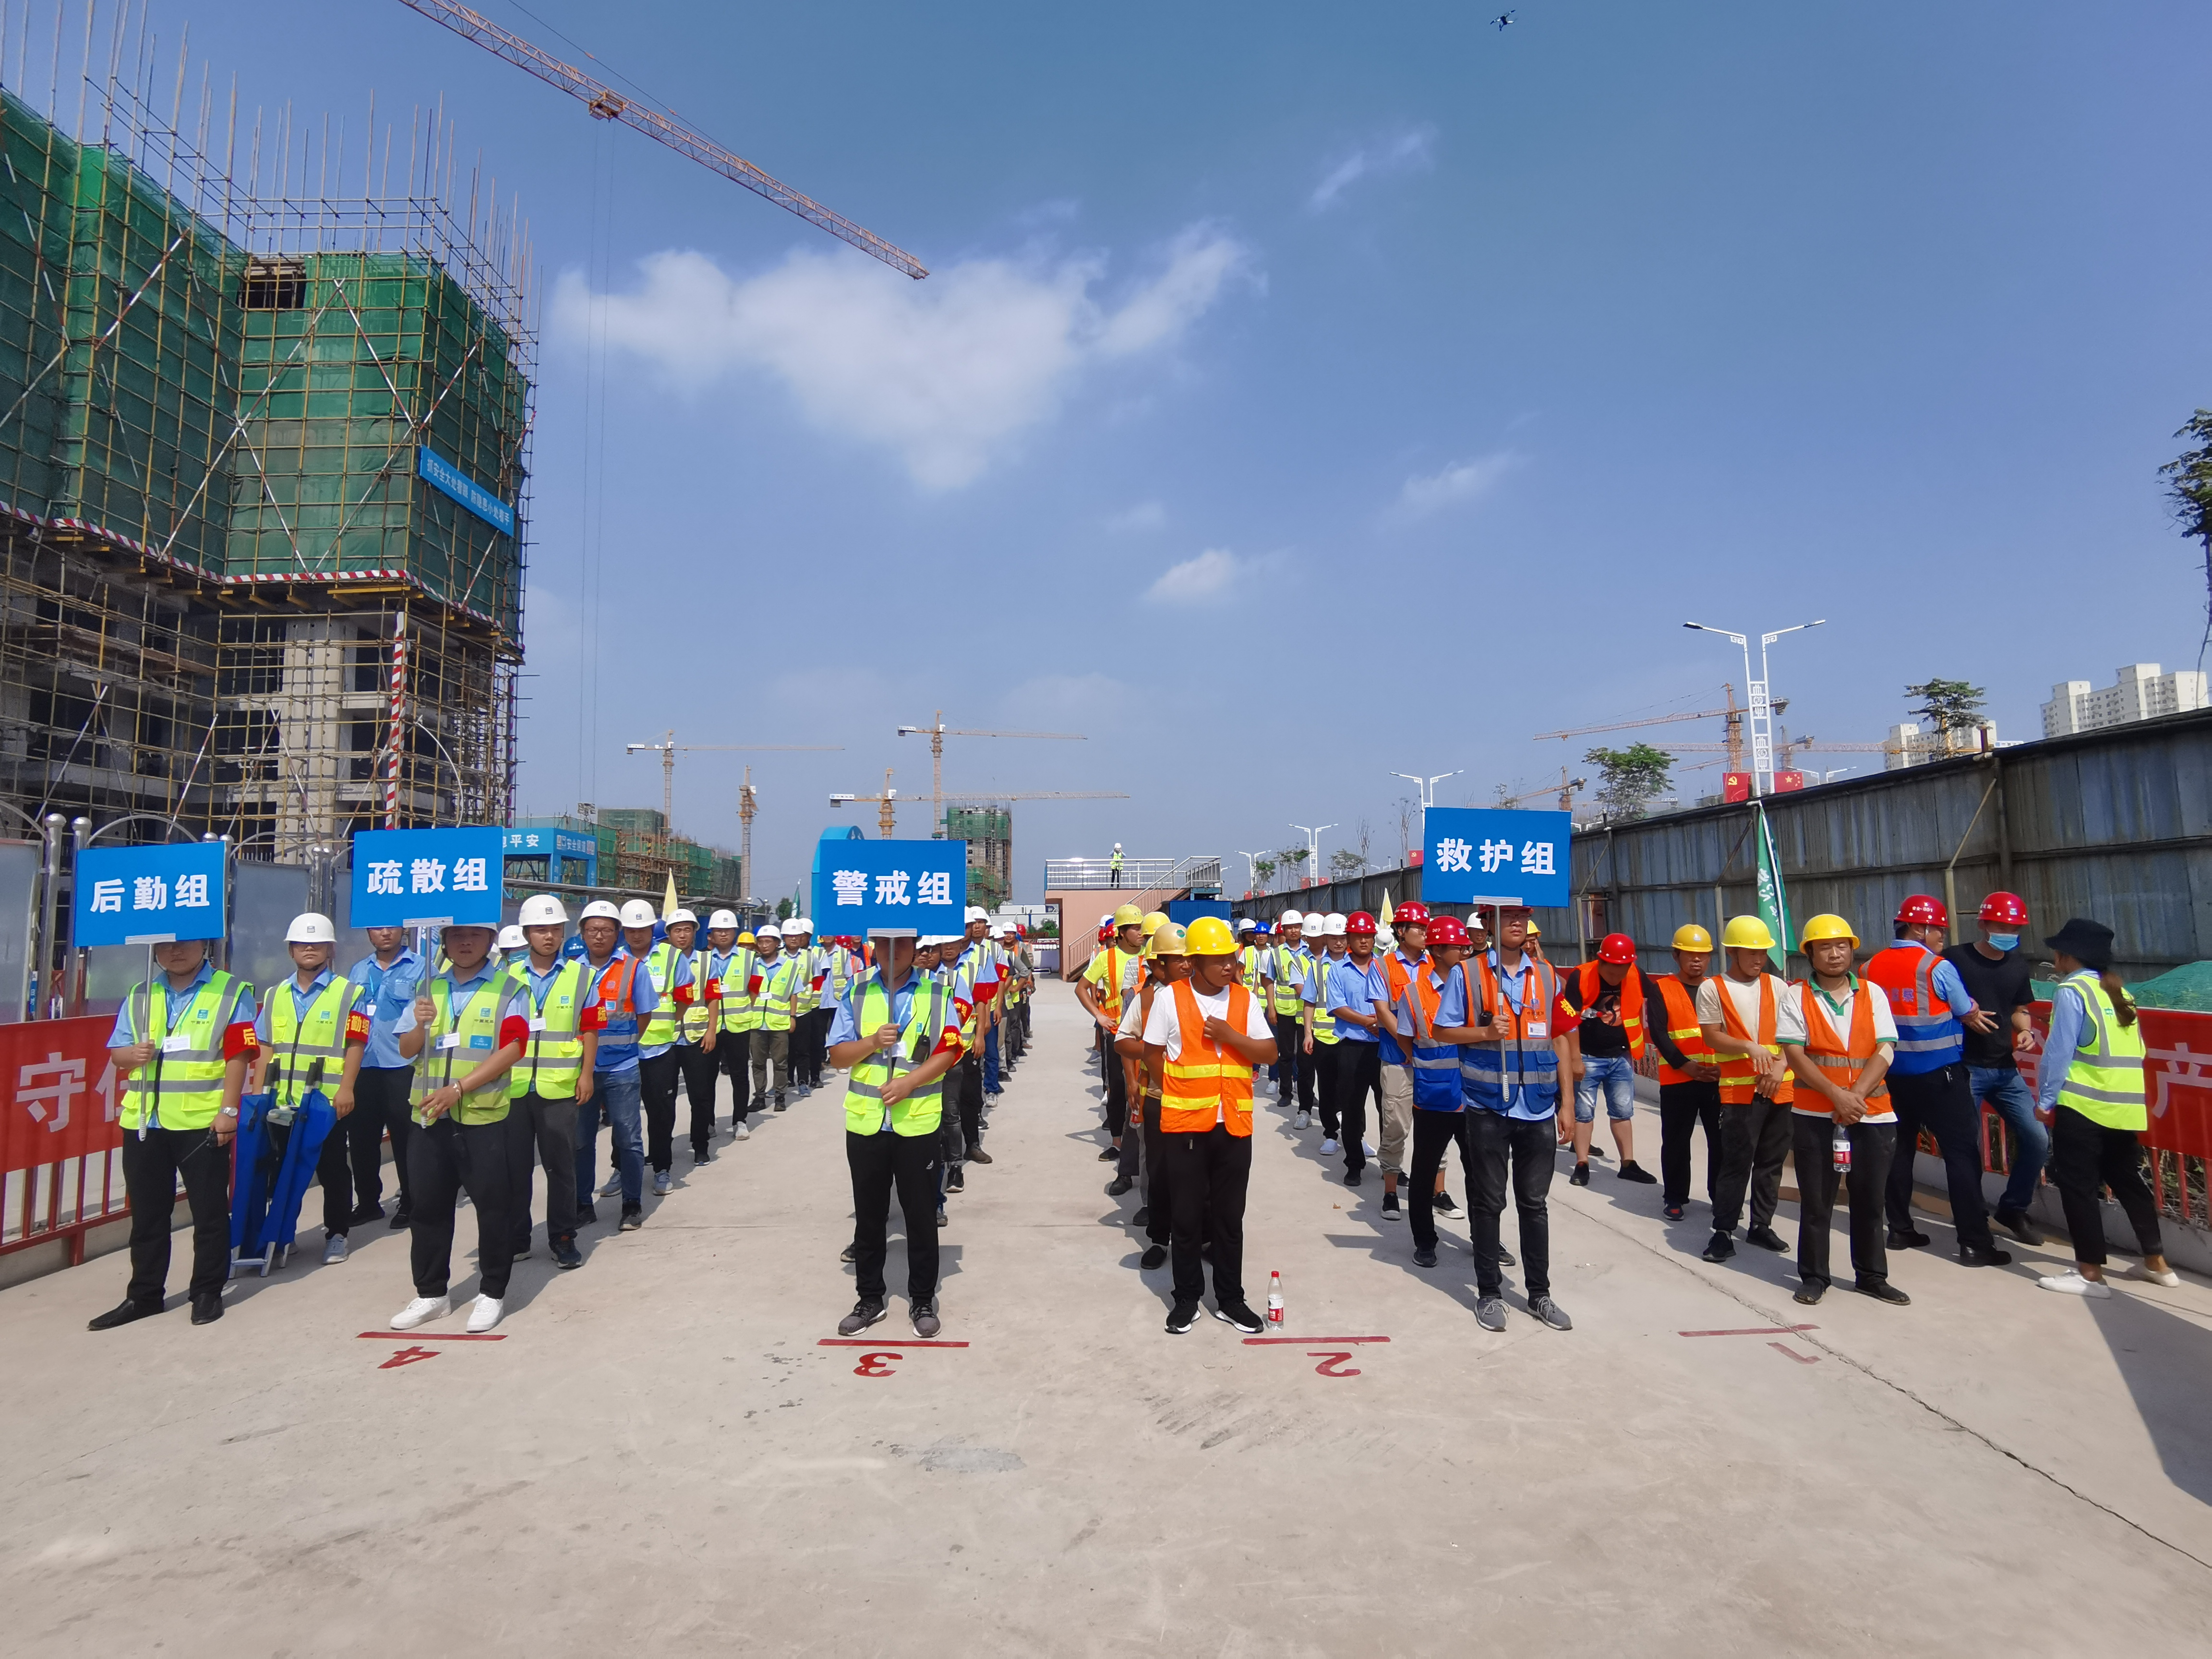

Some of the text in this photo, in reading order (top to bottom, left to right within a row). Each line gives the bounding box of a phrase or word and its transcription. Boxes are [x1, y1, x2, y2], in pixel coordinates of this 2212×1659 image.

[1436, 838, 1556, 875] 救护组
[90, 874, 210, 913] 后勤组
[367, 858, 489, 895] 疏散组
[832, 870, 953, 906] 警戒组
[377, 1346, 442, 1369] 4
[853, 1352, 904, 1378] 3
[1307, 1352, 1362, 1378] 2
